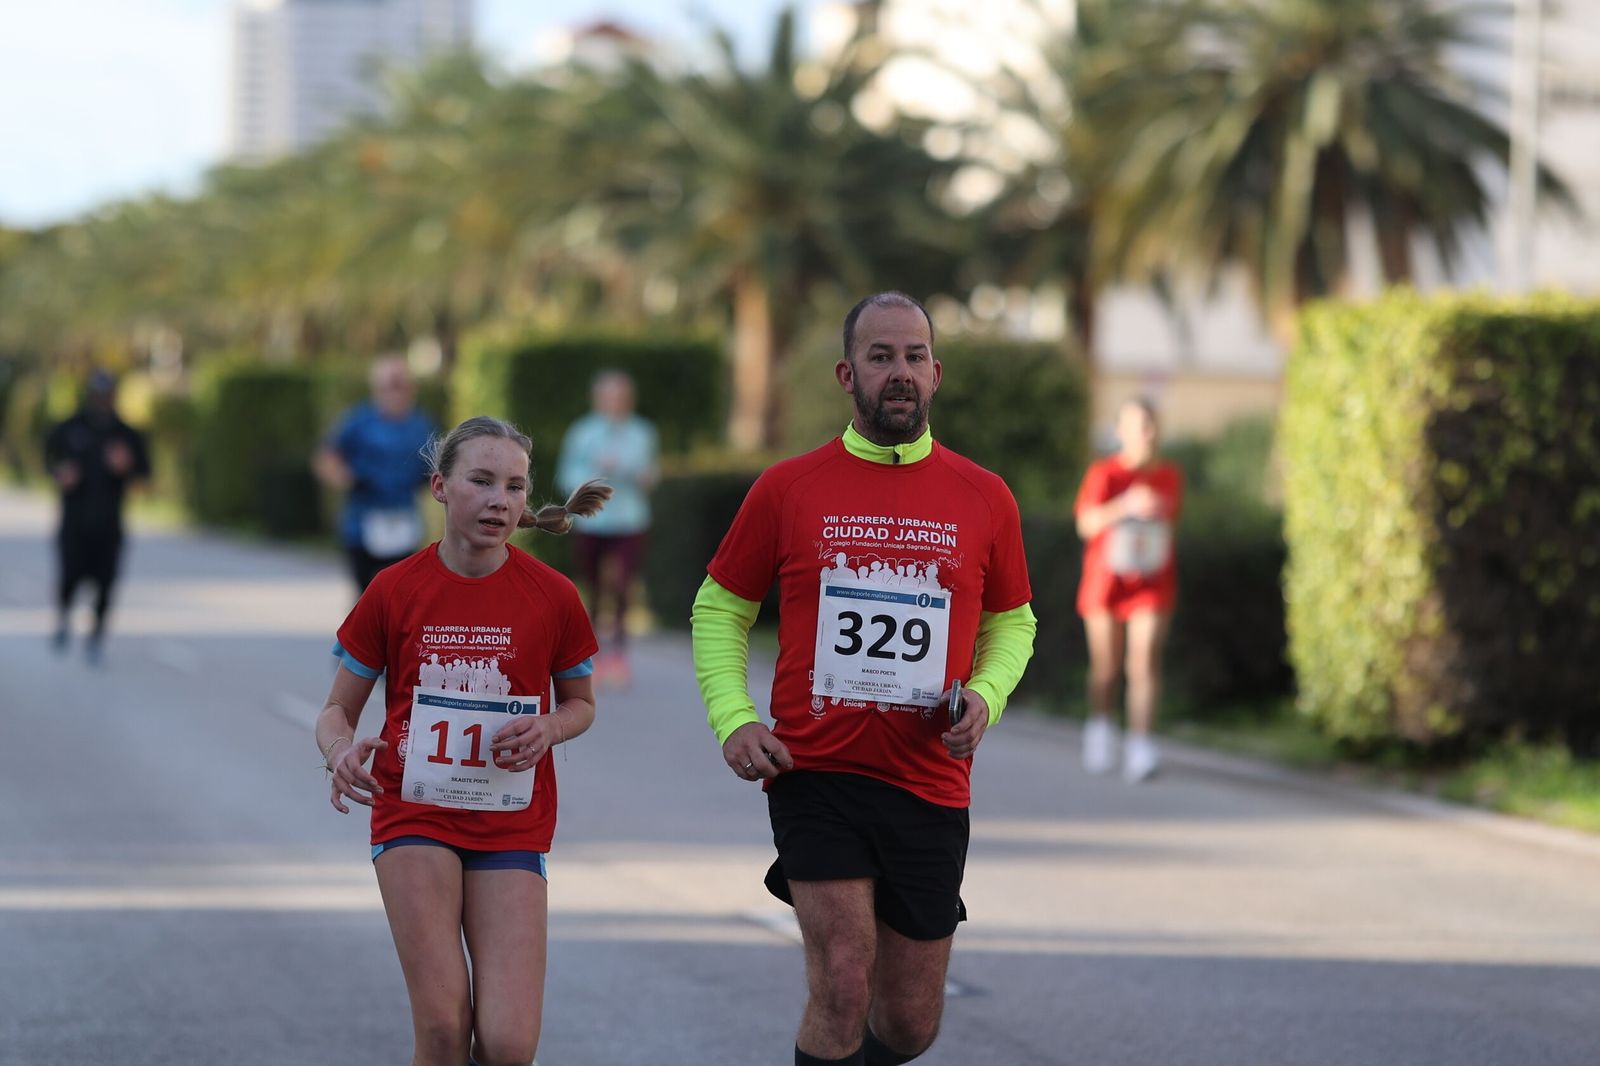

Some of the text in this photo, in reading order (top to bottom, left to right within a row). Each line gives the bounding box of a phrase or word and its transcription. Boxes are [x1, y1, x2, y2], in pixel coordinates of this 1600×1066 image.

[823, 515, 958, 532] VIII CARRERA URBANA DE
[823, 526, 957, 547] CIUDAD JARDÍN
[906, 543, 931, 552] Sagrada
[932, 546, 952, 555] Familia
[836, 589, 898, 601] www.deporte.malaga.eu
[422, 634, 511, 645] CIUDAD JARDÍN
[834, 611, 931, 662] 329
[428, 698, 489, 709] www.deporte.malaga.eu
[843, 698, 866, 708] Unicaja
